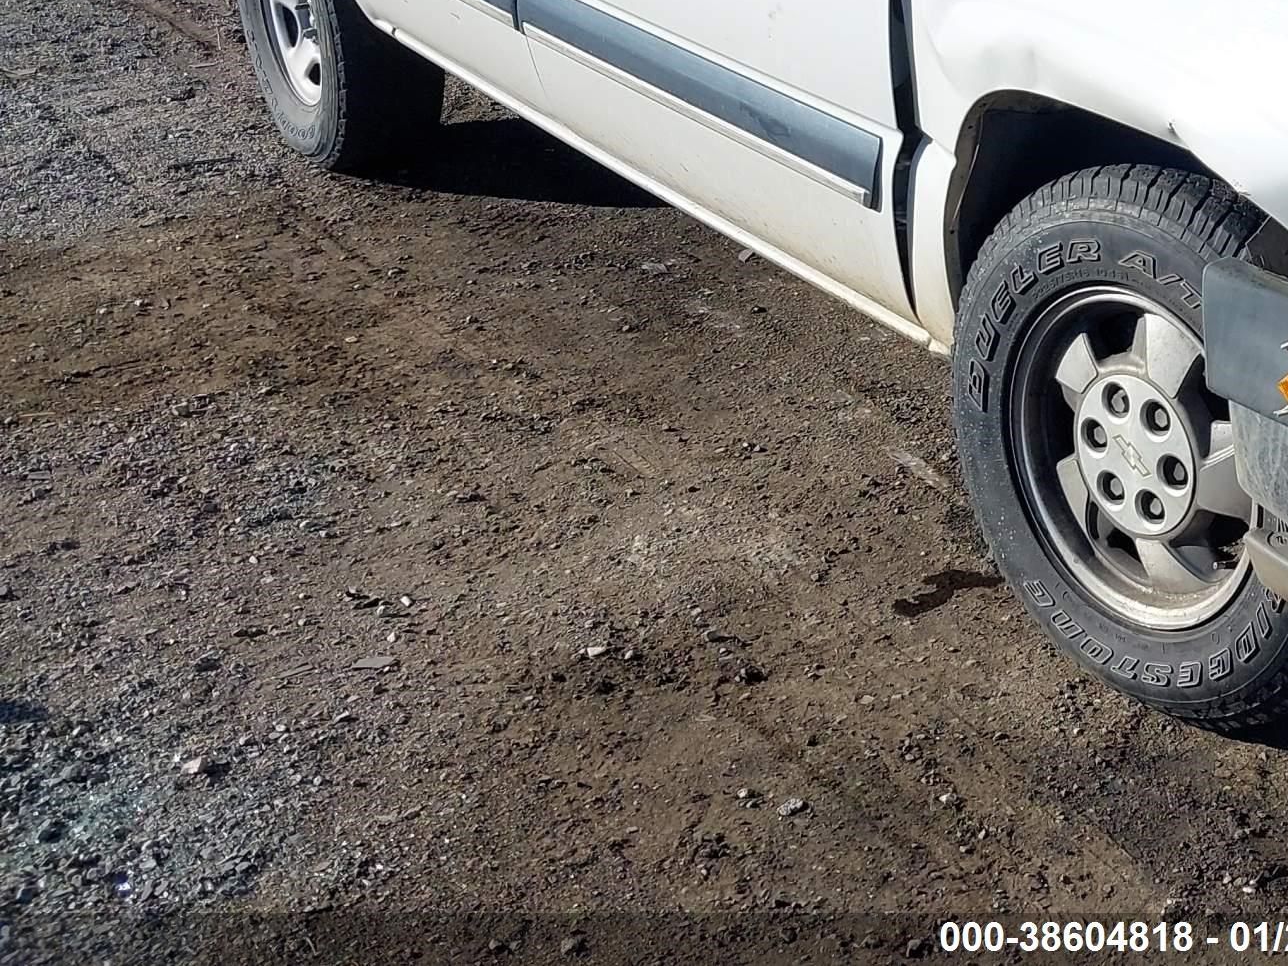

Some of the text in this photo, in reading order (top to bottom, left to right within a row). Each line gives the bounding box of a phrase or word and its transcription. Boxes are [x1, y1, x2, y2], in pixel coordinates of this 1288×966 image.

[968, 238, 1203, 413] DUELER A/T
[1022, 579, 1286, 687] RIDGESTONE
